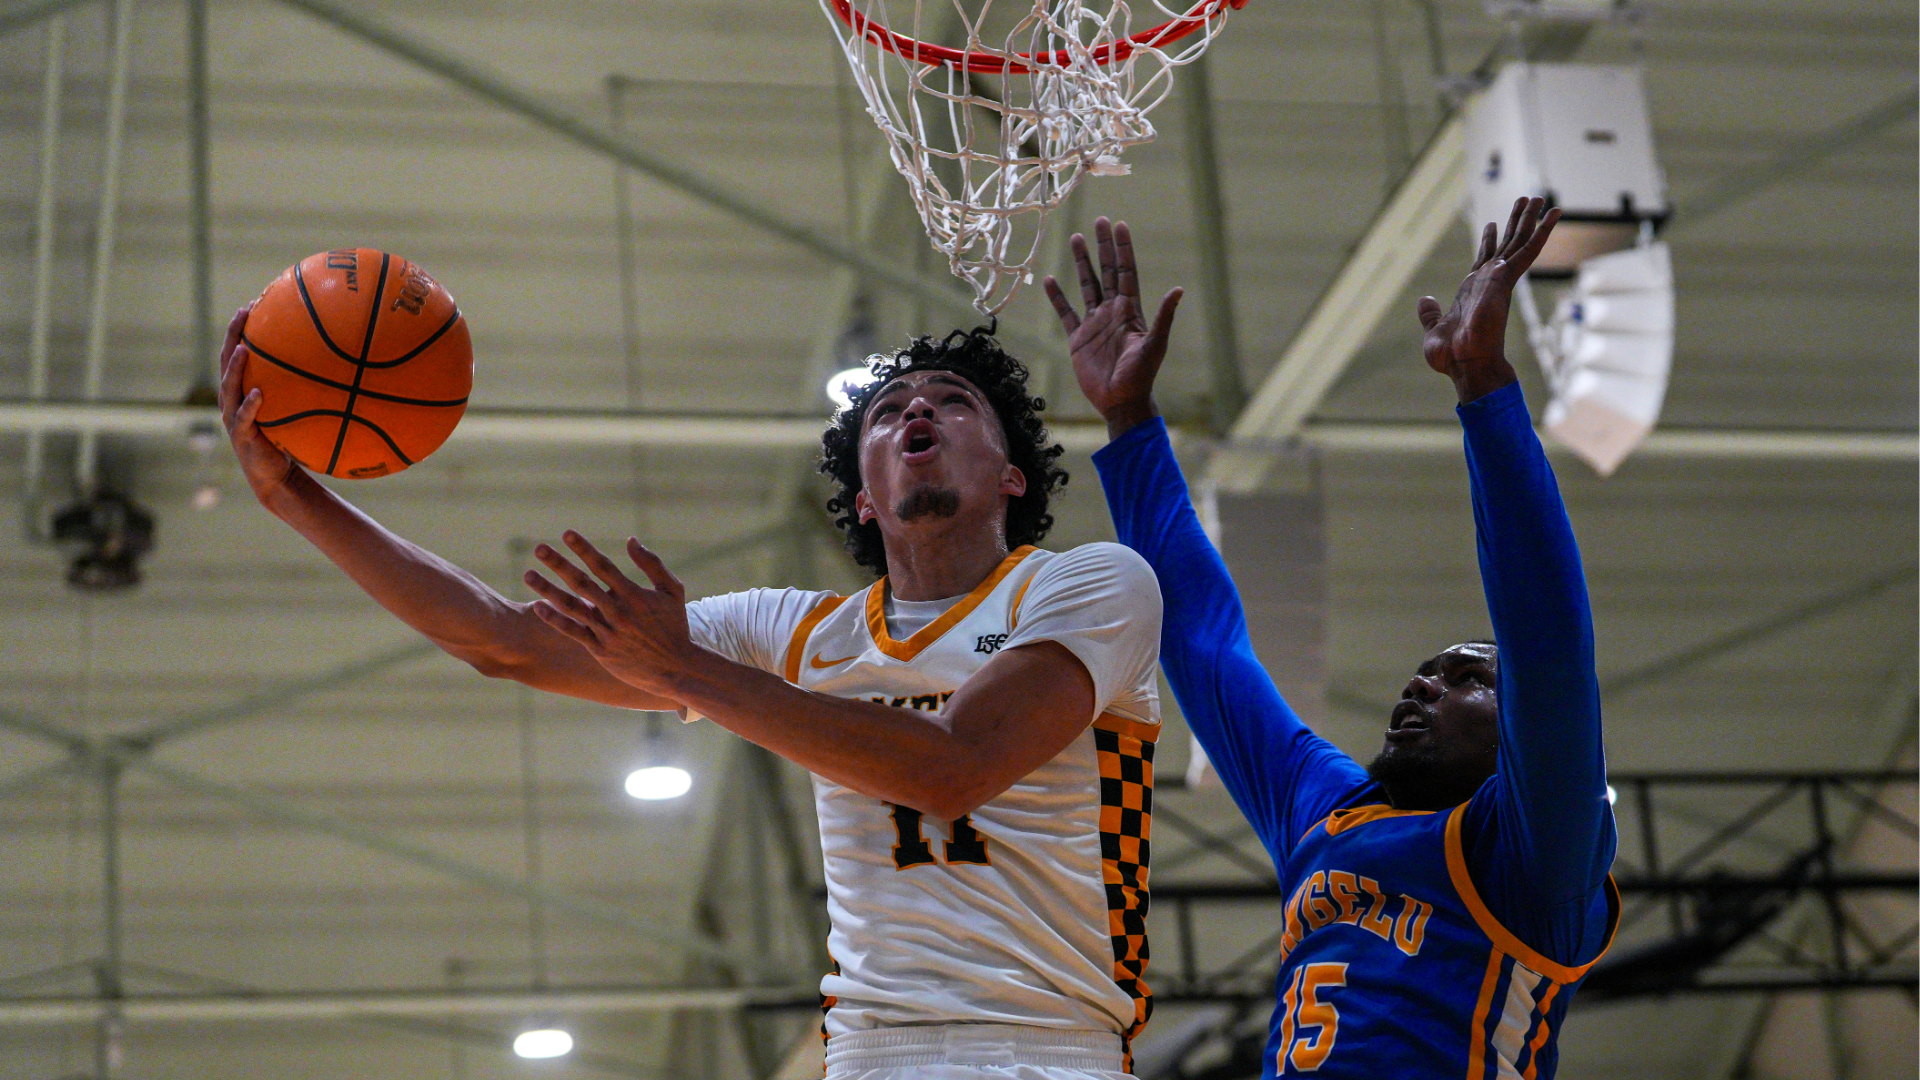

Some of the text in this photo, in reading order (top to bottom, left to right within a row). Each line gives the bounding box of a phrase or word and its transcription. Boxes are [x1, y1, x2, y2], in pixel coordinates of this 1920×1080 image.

[346, 270, 358, 293] NXT
[1281, 869, 1433, 965] NGELO
[1276, 962, 1350, 1077] 15
